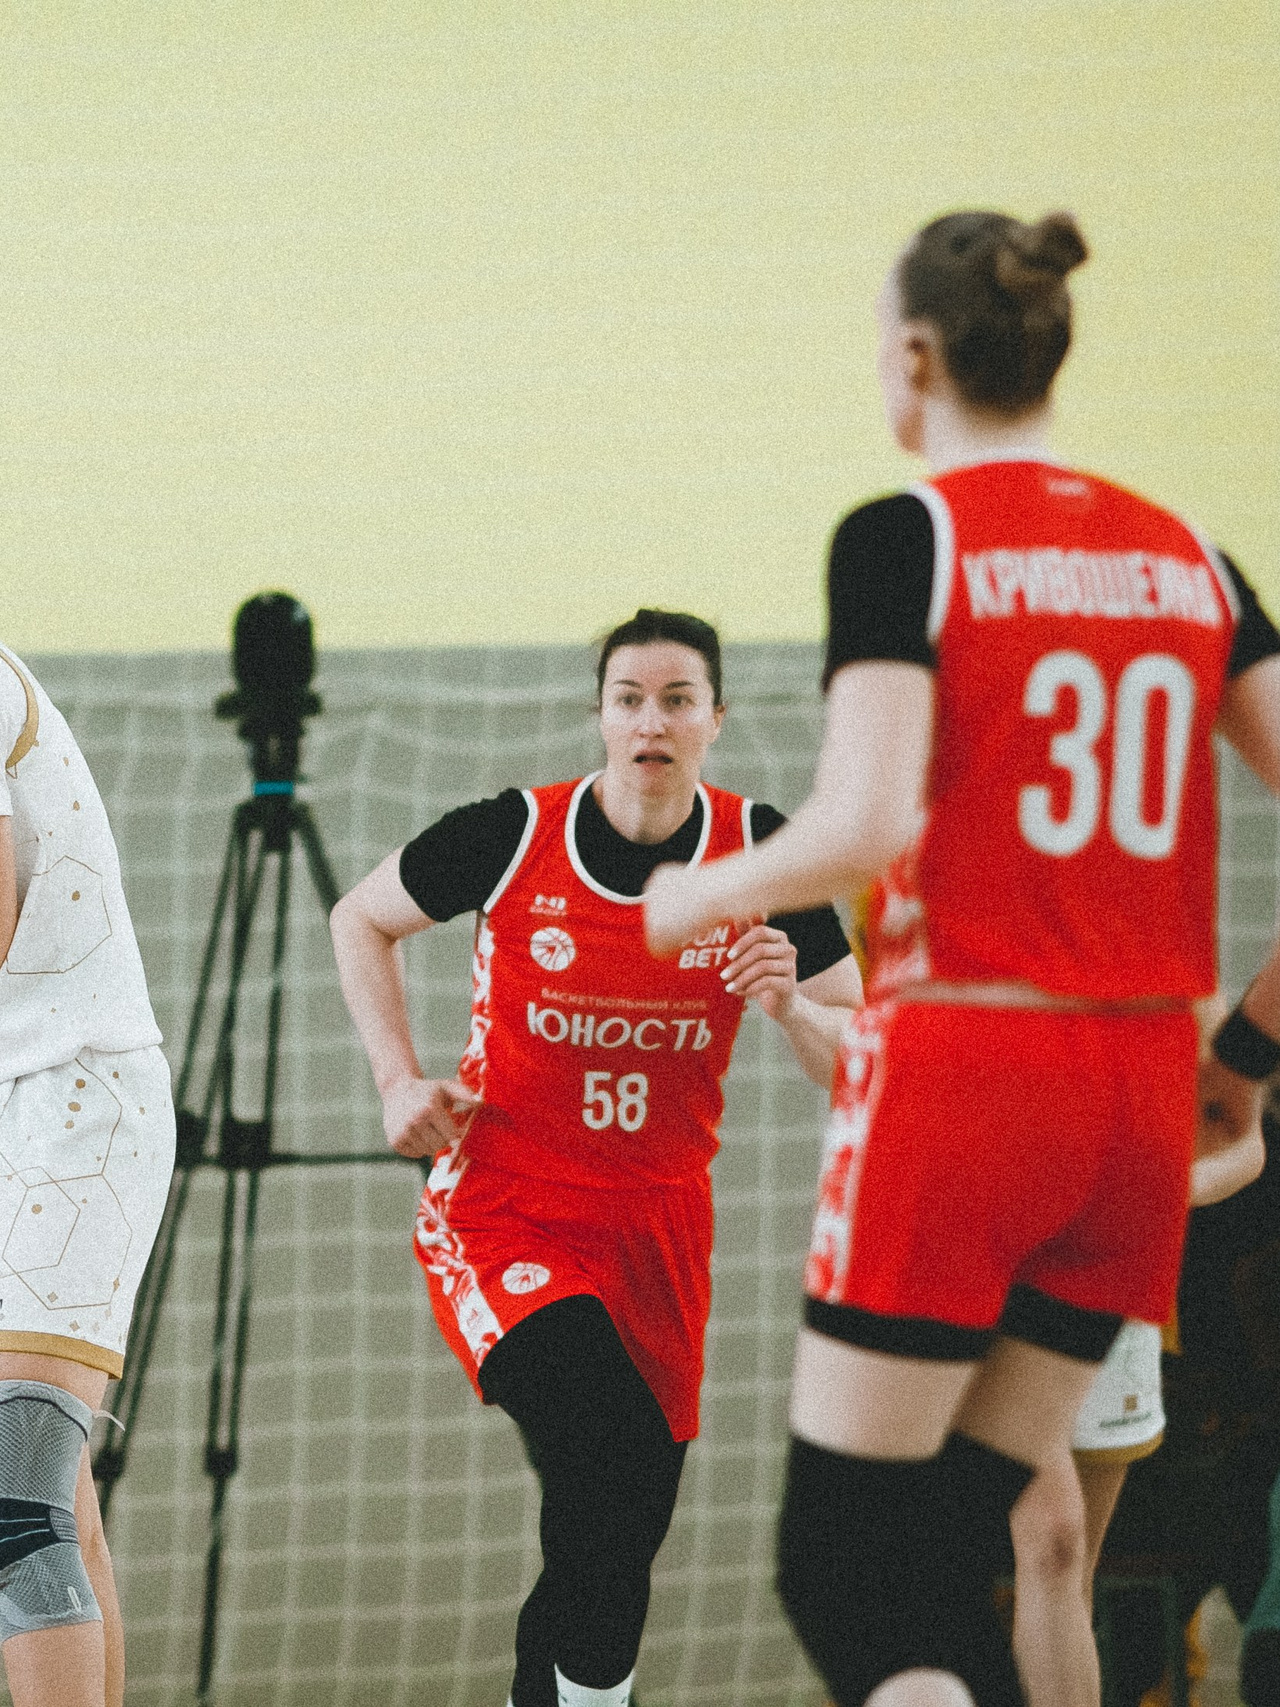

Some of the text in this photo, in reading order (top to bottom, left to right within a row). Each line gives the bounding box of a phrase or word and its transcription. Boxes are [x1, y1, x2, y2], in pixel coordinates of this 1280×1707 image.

[1019, 649, 1197, 860] 30
[678, 946, 728, 970] BET
[526, 1001, 713, 1052] ЮНОСТЬ
[582, 1070, 649, 1132] 58
